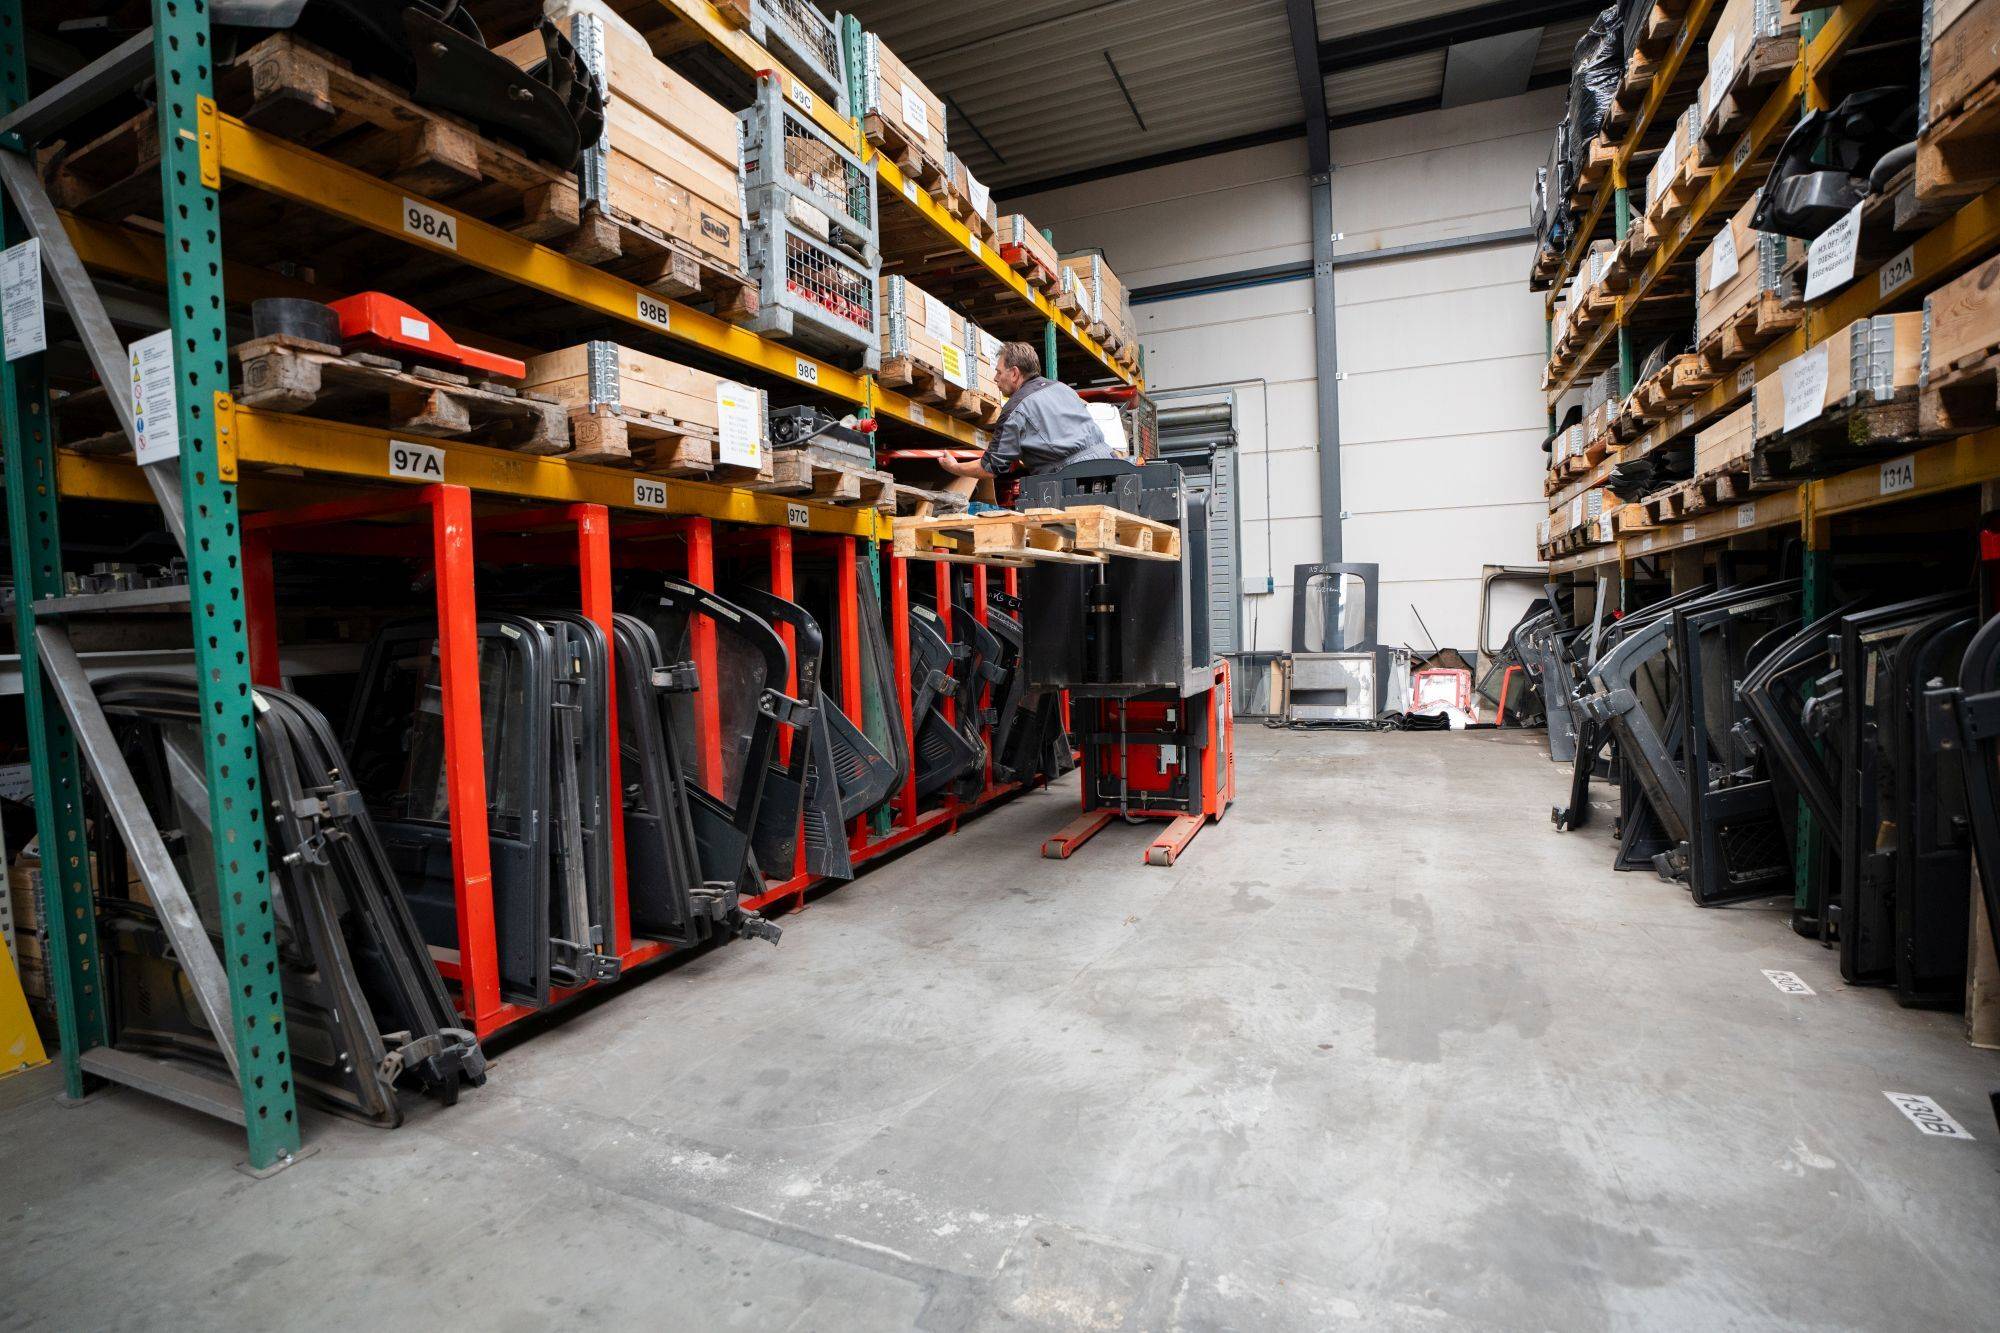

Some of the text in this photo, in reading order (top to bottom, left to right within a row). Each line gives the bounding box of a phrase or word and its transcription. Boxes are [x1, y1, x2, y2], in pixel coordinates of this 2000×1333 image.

[408, 208, 454, 243] 98A
[1827, 220, 1850, 237] HYSTER
[1883, 256, 1912, 290] 132A
[640, 300, 668, 325] 98B
[798, 363, 816, 381] 98C
[394, 449, 441, 475] 97A
[1883, 465, 1912, 488] 131A
[637, 485, 665, 504] 97B
[789, 508, 808, 523] 97C
[1896, 1097, 1957, 1134] 130B
